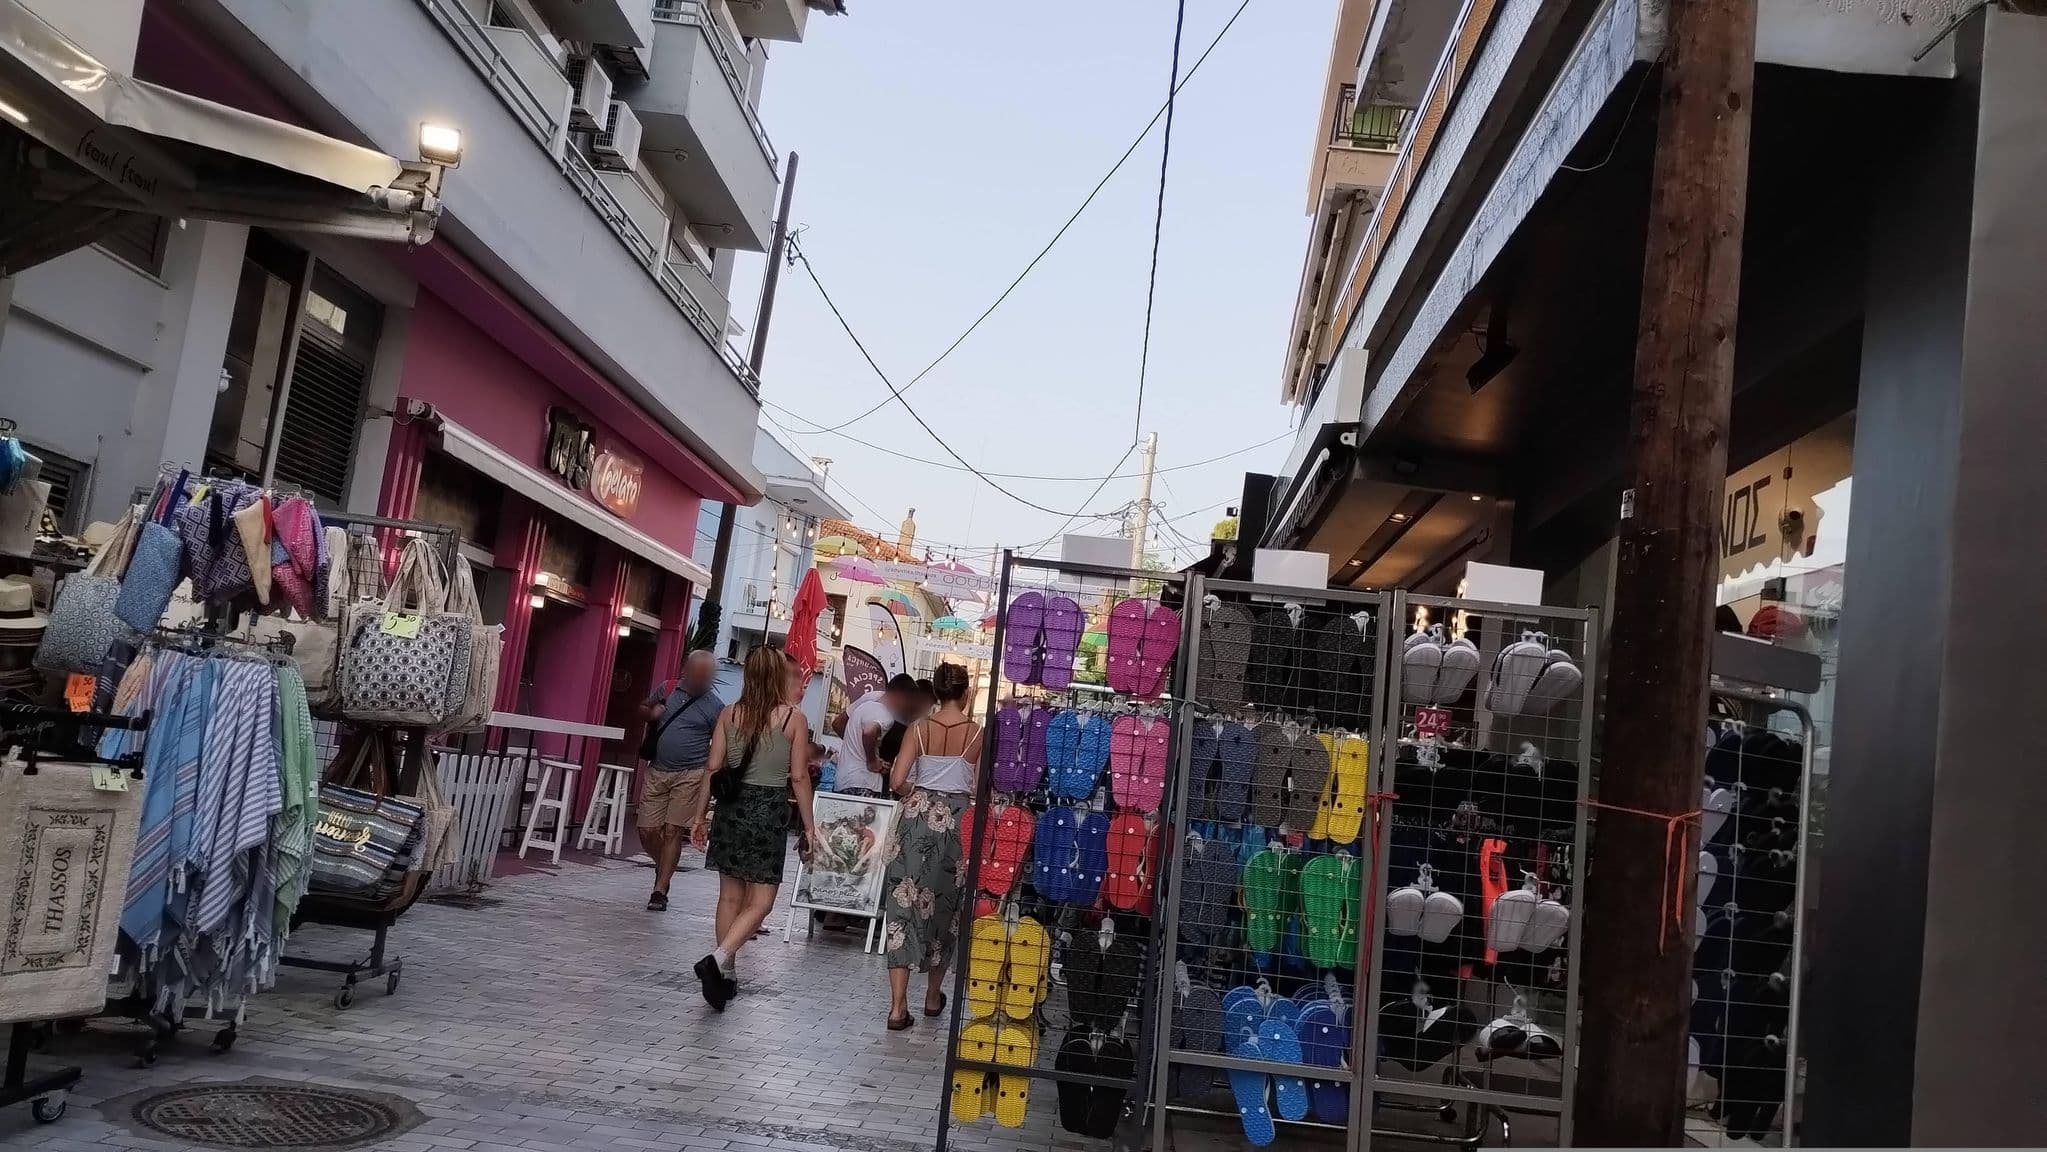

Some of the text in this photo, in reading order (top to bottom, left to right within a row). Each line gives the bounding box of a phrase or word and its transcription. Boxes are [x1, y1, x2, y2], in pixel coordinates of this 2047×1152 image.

[600, 455, 639, 505] Gelato
[1417, 711, 1437, 729] 24
[44, 847, 71, 934] THASSOS
